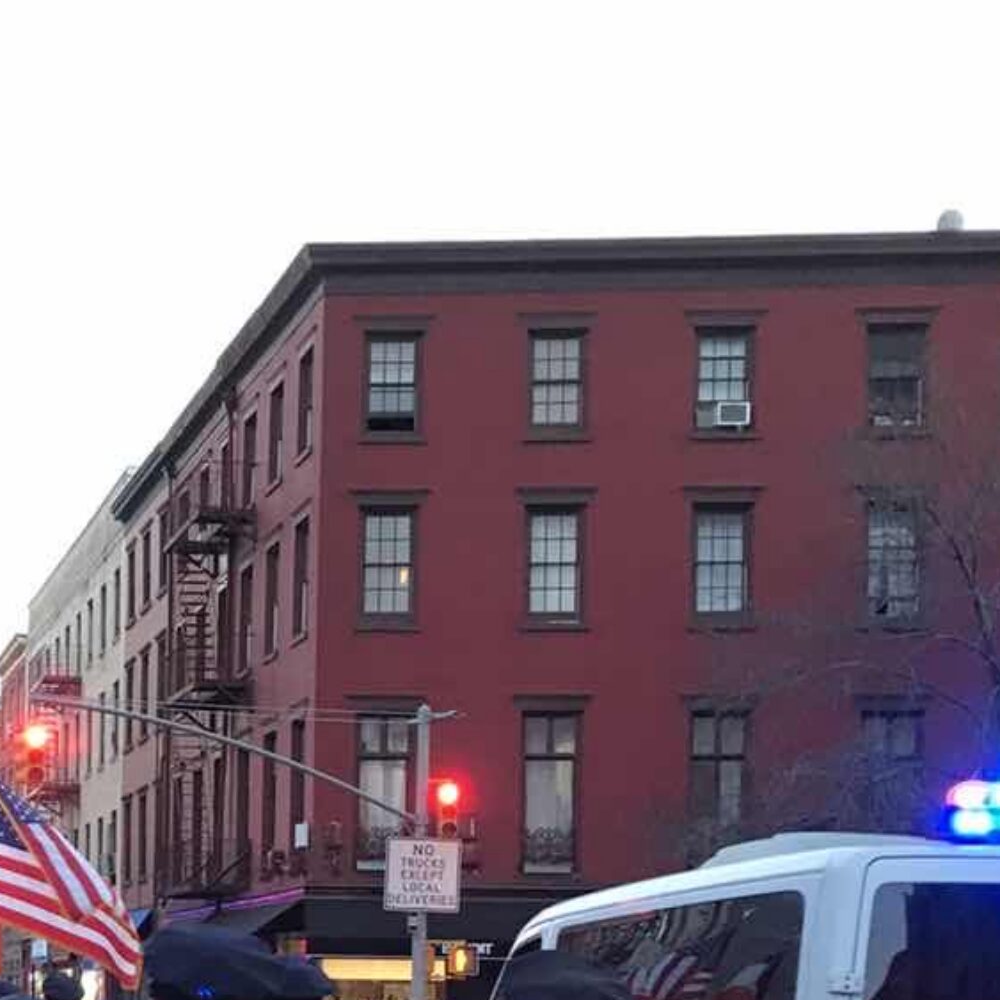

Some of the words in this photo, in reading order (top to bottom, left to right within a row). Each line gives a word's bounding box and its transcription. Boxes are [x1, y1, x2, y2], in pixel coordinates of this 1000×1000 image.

[412, 844, 434, 855] NO
[401, 857, 445, 869] TRUCKS
[401, 869, 443, 881] EXCEPT
[402, 882, 442, 893] LOCAL
